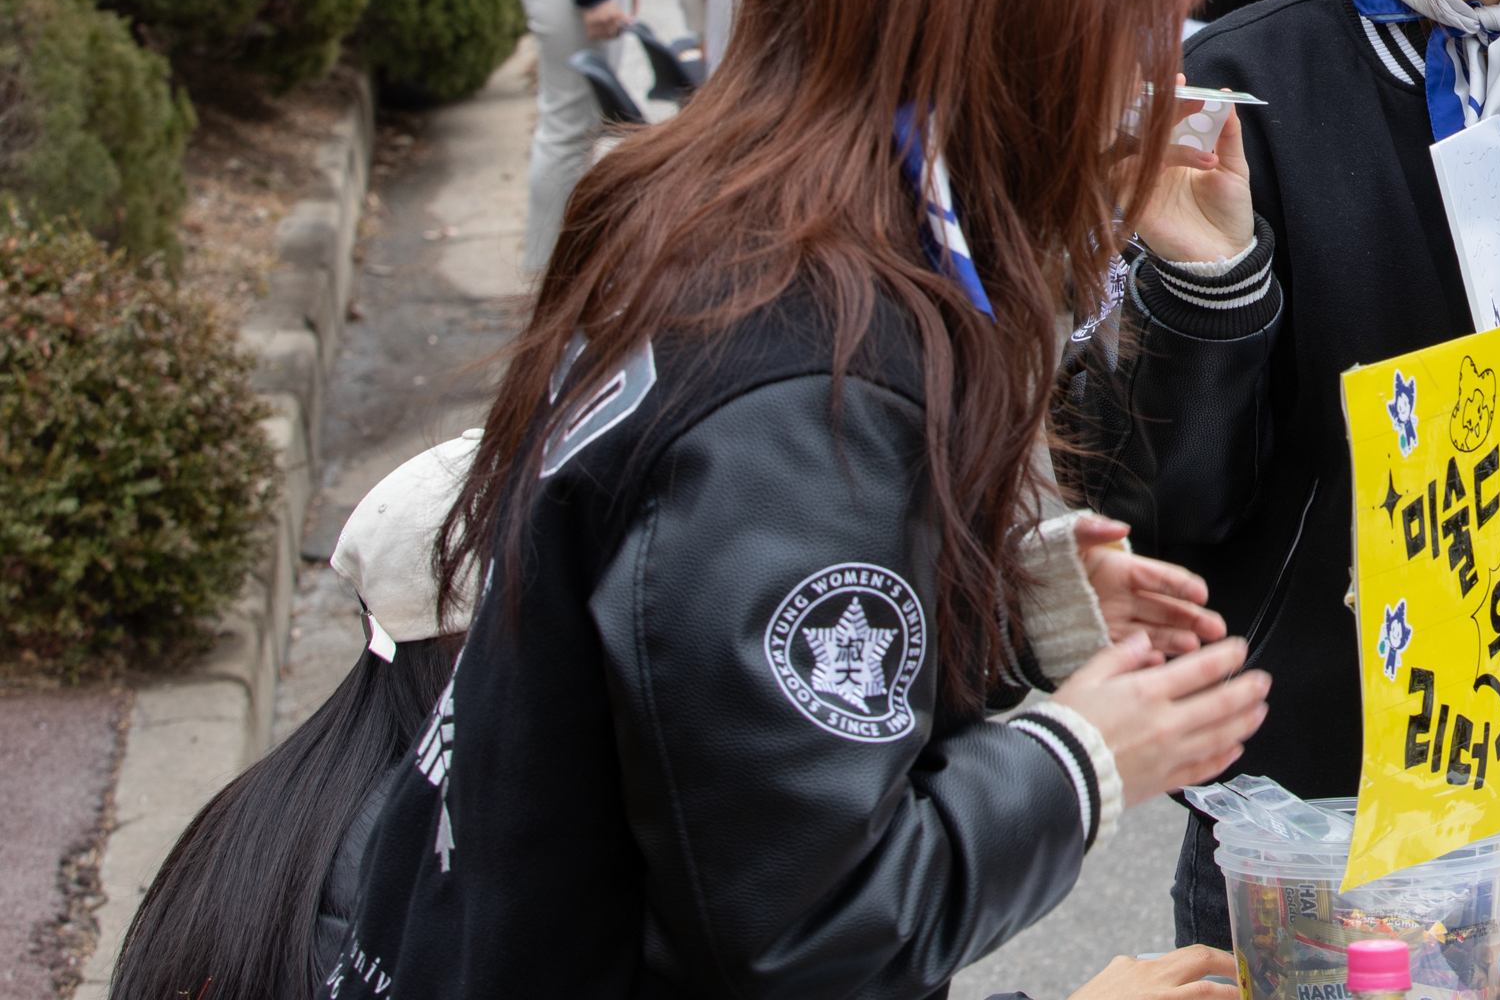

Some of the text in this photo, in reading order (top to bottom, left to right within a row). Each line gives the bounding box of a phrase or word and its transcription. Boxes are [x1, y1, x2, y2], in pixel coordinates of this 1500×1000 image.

[771, 594, 822, 714] SOOKMYUNG
[810, 570, 903, 599] WOMEN'S
[826, 712, 880, 737] SINCE
